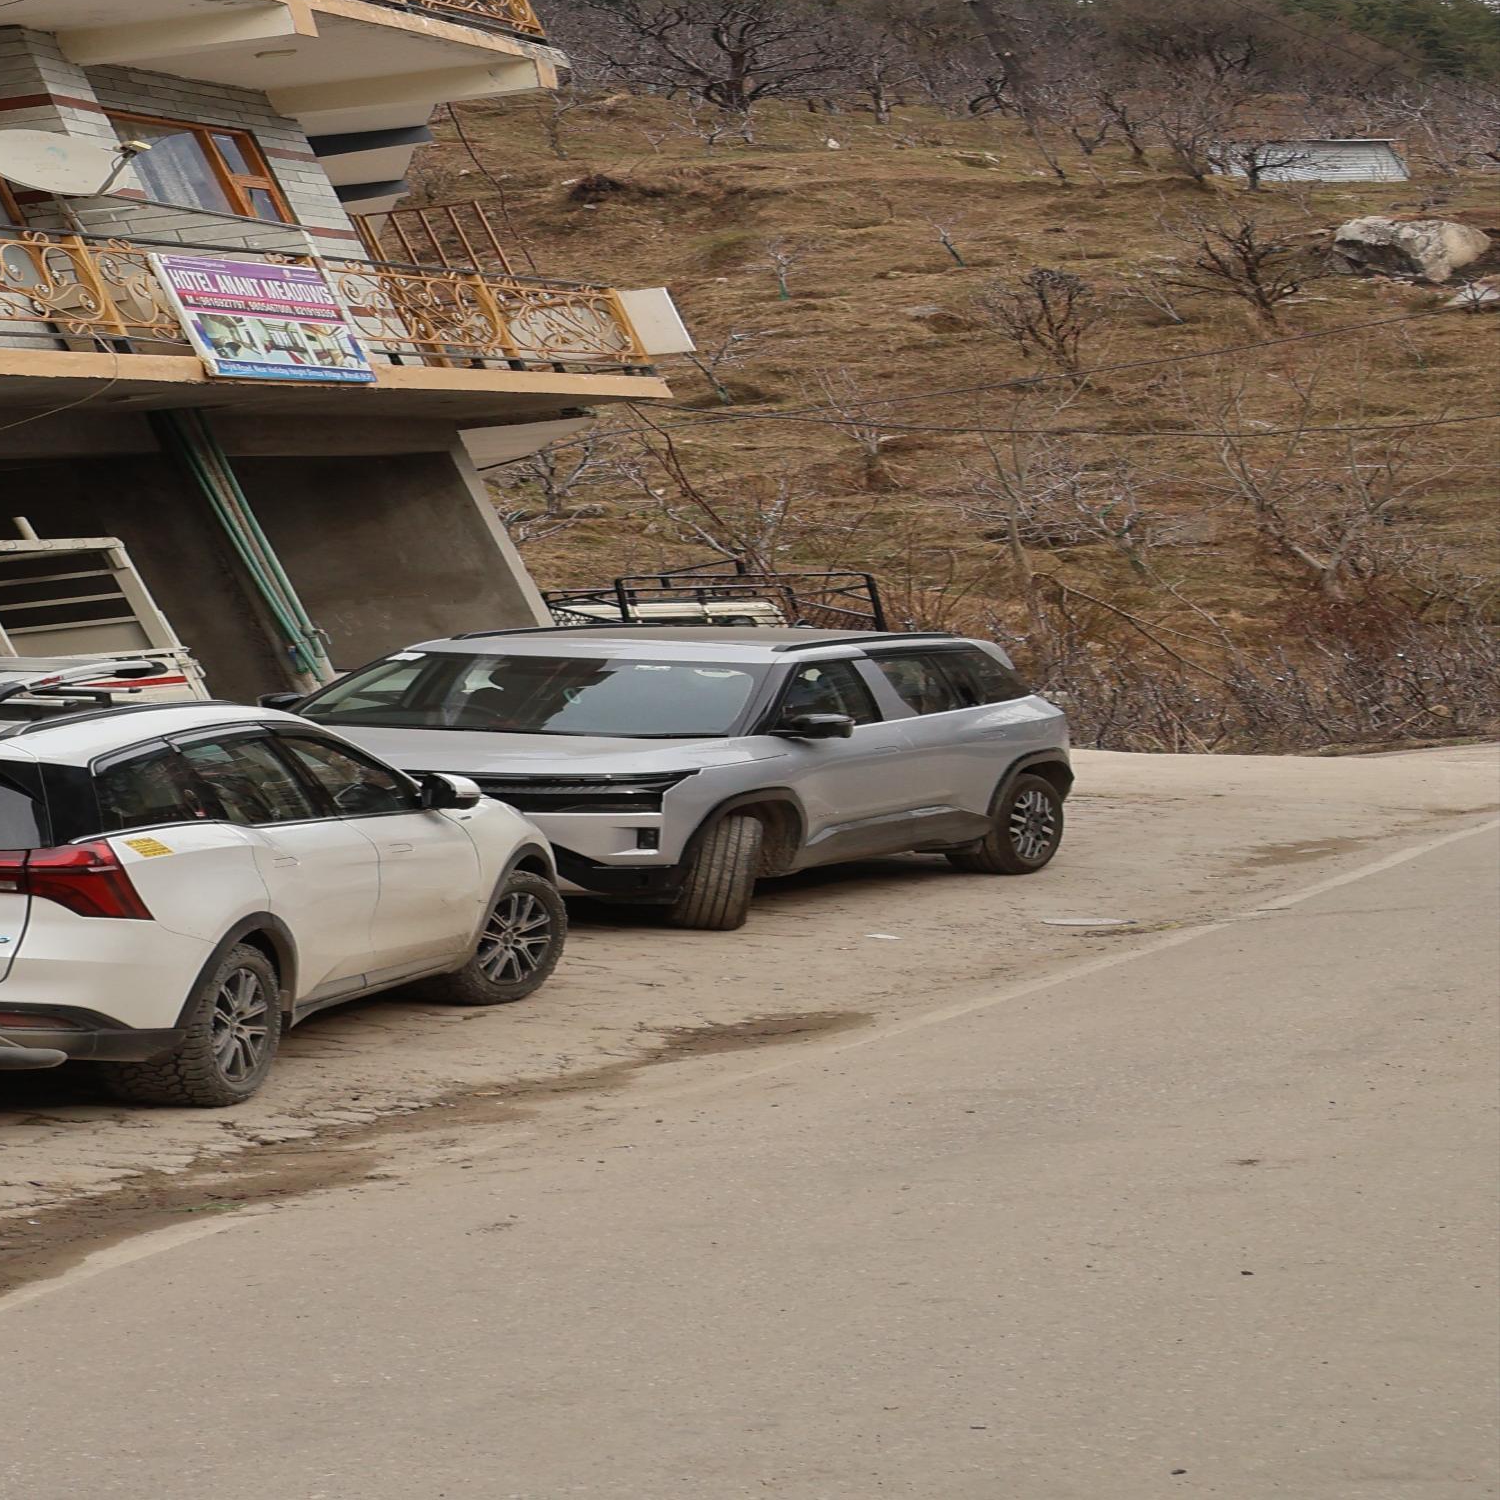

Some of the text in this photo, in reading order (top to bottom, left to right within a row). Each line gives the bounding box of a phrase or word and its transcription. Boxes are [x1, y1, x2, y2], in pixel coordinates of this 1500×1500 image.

[169, 269, 335, 305] HOTEL ANANT MEADOWS
